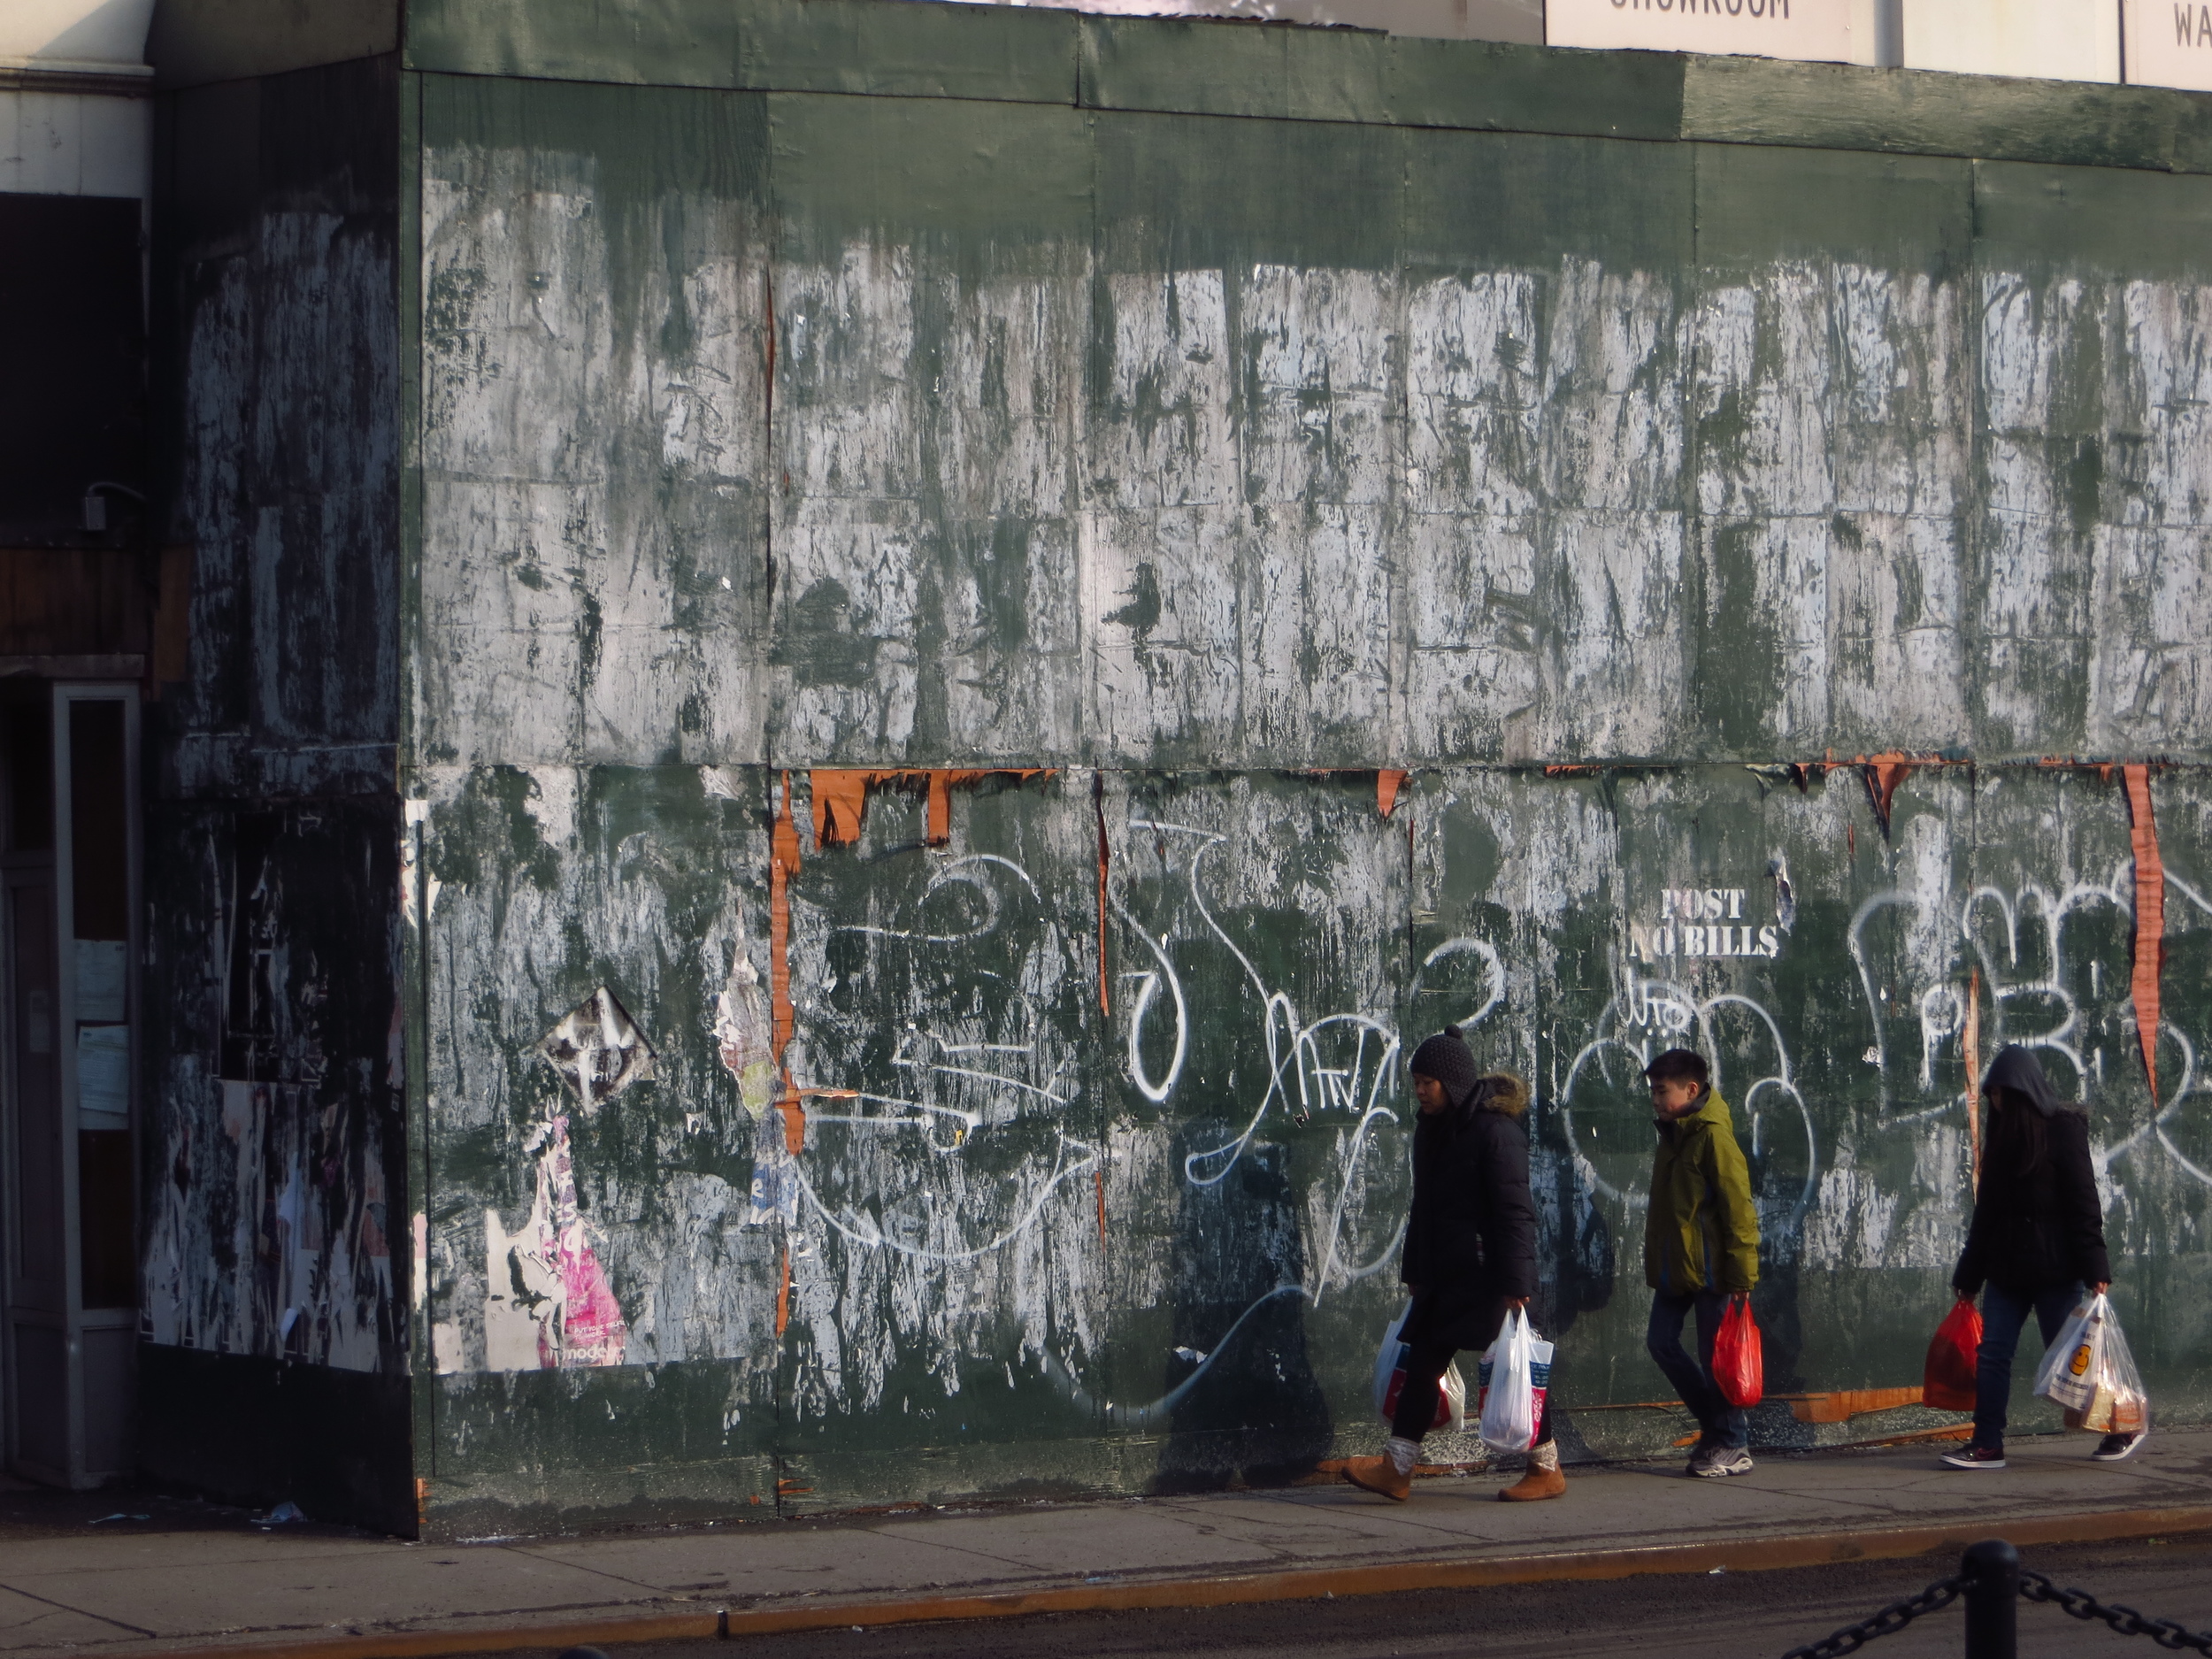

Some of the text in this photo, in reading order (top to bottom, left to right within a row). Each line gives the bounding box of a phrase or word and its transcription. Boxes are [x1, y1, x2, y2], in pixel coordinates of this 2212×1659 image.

[1661, 888, 1745, 919] POST
[1629, 926, 1778, 957] NO BILLS
